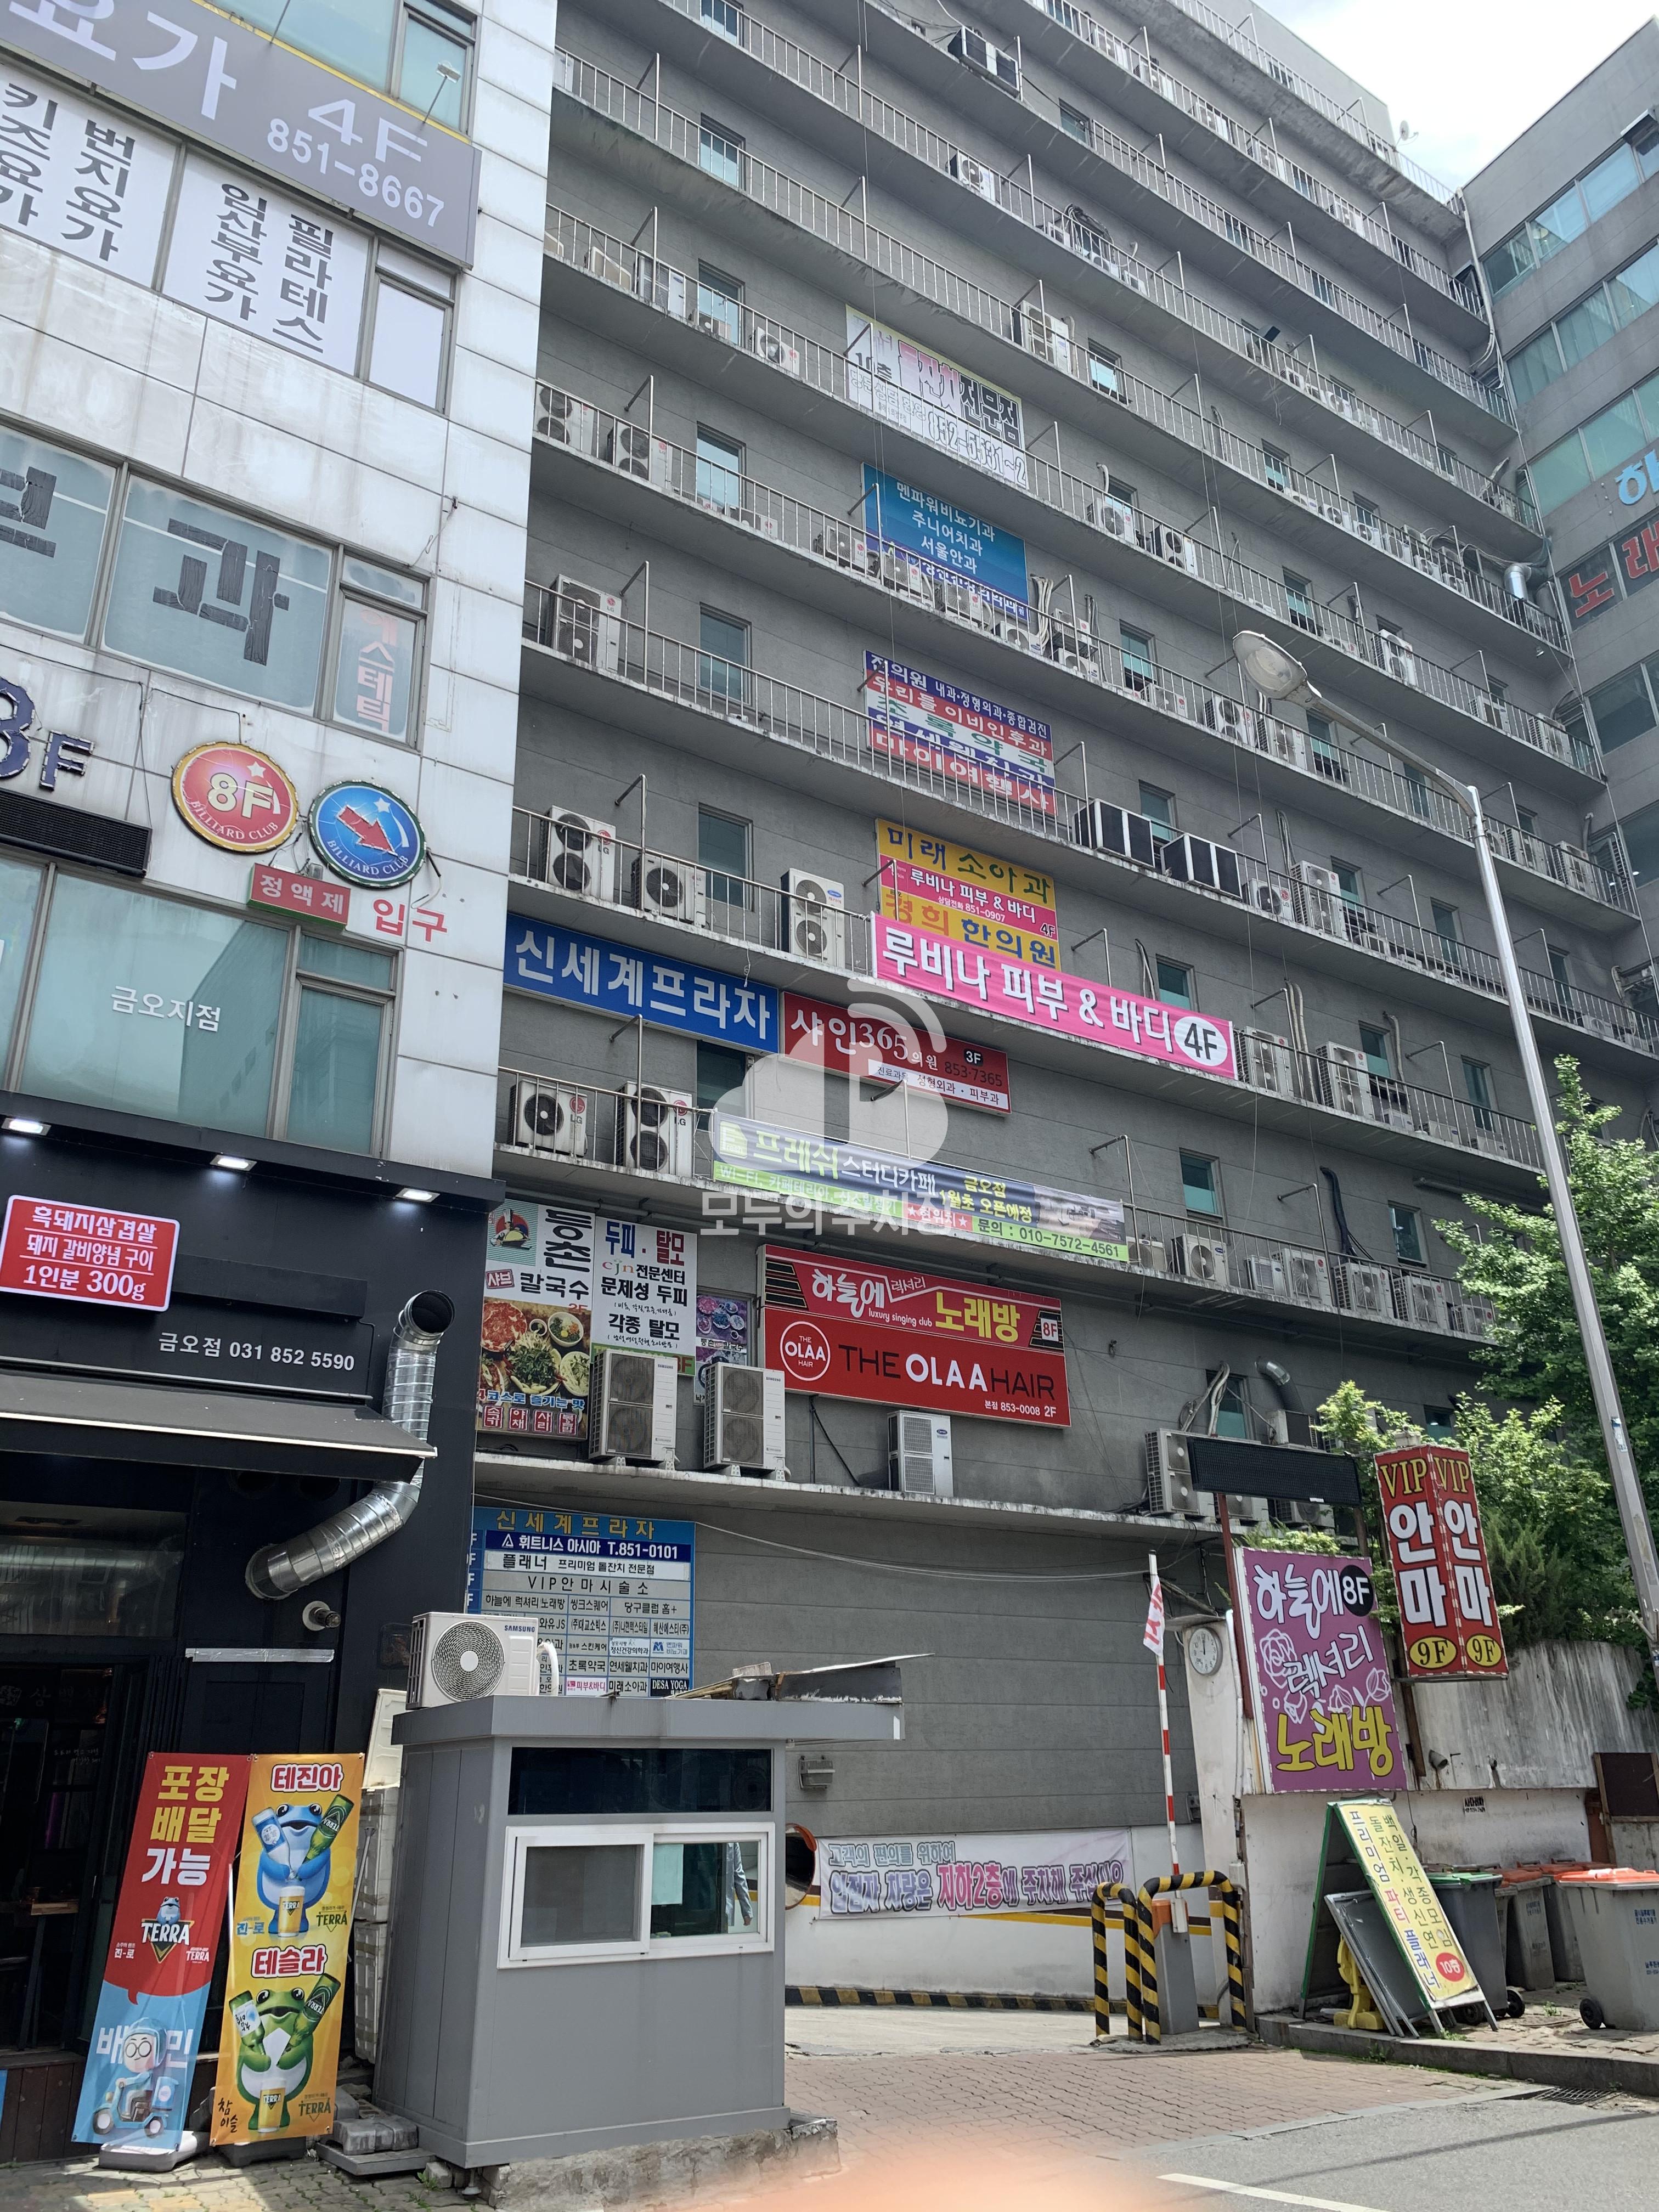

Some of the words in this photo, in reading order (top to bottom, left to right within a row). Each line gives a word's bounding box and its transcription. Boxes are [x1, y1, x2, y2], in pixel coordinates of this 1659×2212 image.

[307, 98, 428, 163] 4F
[267, 118, 445, 228] 851-8667
[204, 183, 268, 321] 임산부요가
[272, 214, 334, 354] 필라테스
[960, 373, 1021, 449] 전문점
[896, 481, 996, 543] 멘파워비뇨기과
[911, 509, 983, 557] 주니어치과
[921, 535, 978, 575] 서울안과
[876, 732, 1049, 810] 마이여행사
[207, 772, 274, 819] 8F
[191, 800, 245, 840] BILLIARD
[248, 821, 279, 840] CLUB
[327, 839, 380, 876] BILLIARD
[382, 855, 409, 875] CLUB
[259, 873, 345, 915] 정액제
[910, 868, 956, 898] 루비나
[960, 884, 989, 906] 피부
[992, 896, 1005, 912] &
[1007, 899, 1036, 924] 바디
[937, 895, 964, 911] 상담전화
[964, 902, 1006, 923] 851-0907
[373, 898, 448, 943] 입구
[1040, 923, 1056, 937] 4F
[515, 930, 770, 1041] 신세계프라자
[882, 927, 991, 1001] 루비나
[1001, 963, 1069, 1021] 피부
[1079, 989, 1104, 1028] &
[1109, 996, 1173, 1053] 바디
[1183, 1022, 1217, 1060] 4F
[110, 985, 221, 1033] 금오지점
[966, 1050, 981, 1064] 3F
[917, 1074, 956, 1094] 성형외과
[969, 1087, 1000, 1105] 피부과
[753, 1130, 839, 1180] 프레쉬
[840, 1155, 936, 1197] 스터디카페
[964, 1175, 1007, 1199] 금오점
[32, 1206, 157, 1243] 흑돼지삼겹살
[939, 1189, 975, 1212] 1월초
[979, 1197, 1032, 1224] 오픈예정
[27, 1233, 58, 1257] 돼지
[62, 1238, 121, 1266] 갈비양념
[124, 1251, 154, 1272] 구이
[543, 1209, 592, 1273] 등촌
[605, 1221, 636, 1258] 두피
[656, 1229, 685, 1266] 탈모
[977, 1218, 1003, 1237] 문의
[1019, 1227, 1120, 1257] 010-7572-4561
[24, 1264, 80, 1291] 1인분
[86, 1269, 145, 1301] 300g
[520, 1272, 589, 1300] 칼국수
[601, 1276, 649, 1301] 문제성
[657, 1285, 687, 1307] 두피
[636, 1264, 685, 1285] 전문센터
[811, 1268, 885, 1318] 하늘에
[890, 1276, 926, 1294] 럭셔리
[934, 1291, 1021, 1343] 노래방
[1042, 1318, 1059, 1340] 8F
[868, 1307, 890, 1323] luxury
[891, 1312, 917, 1328] singing
[918, 1316, 933, 1328] club
[608, 1313, 641, 1334] 각종
[649, 1319, 680, 1340] 탈모
[799, 1335, 812, 1344] THE
[159, 1331, 222, 1358] 금오점
[229, 1342, 262, 1361] 031
[270, 1346, 304, 1366] 852
[311, 1351, 355, 1372] 5590
[785, 1340, 826, 1362] OLAA
[798, 1360, 814, 1368] HAIR
[838, 1344, 901, 1379] THE
[991, 1367, 1056, 1401] HAIR
[512, 1409, 526, 1429] 야채
[530, 1394, 568, 1409] 즐기는
[572, 1399, 585, 1410] 맛
[984, 1400, 998, 1411] 본점
[1000, 1401, 1041, 1417] 853-0008
[1043, 1405, 1057, 1418] 2F
[538, 1412, 550, 1431] 사리
[1380, 1457, 1427, 1498] VIP
[1433, 1456, 1470, 1494] VIP
[496, 1510, 654, 1540] 신세계프라자
[503, 1554, 547, 1570] 플래너
[558, 1559, 595, 1572] 프리미엄
[599, 1561, 625, 1573] 돌잔치
[628, 1564, 654, 1575] 전문점
[519, 1534, 564, 1551] 휘트니스
[567, 1538, 601, 1555] 아시아
[607, 1541, 678, 1560] T.851-0101
[1389, 1500, 1448, 1628] 안마
[1443, 1499, 1494, 1627] 안마
[486, 1594, 511, 1607] 하늘에
[515, 1596, 539, 1609] 럭셔리
[541, 1598, 565, 1611] 노래방
[624, 1601, 659, 1615] 당구클럽
[1253, 1563, 1344, 1640] 하늘에
[1342, 1576, 1372, 1606] 8F
[581, 1643, 607, 1651] 스킨케어
[610, 1646, 648, 1655] 정신건강의학과
[1419, 1639, 1449, 1666] 9F
[1471, 1637, 1497, 1663] 9F
[568, 1659, 606, 1673] 초록약국
[651, 1662, 689, 1674] 마이여행사
[576, 1680, 606, 1691] 피부&바디
[608, 1680, 647, 1692] 미래소아과
[652, 1679, 669, 1690] DESA
[670, 1679, 688, 1691] YOGA
[1276, 1705, 1394, 1777] 노래방
[157, 1765, 230, 1803] 포장
[273, 1764, 344, 1791] 테진아
[150, 1807, 222, 1844] 배달
[1381, 1814, 1408, 1852] 백일
[829, 1842, 870, 1867] 고객의
[873, 1841, 913, 1866] 편의를
[917, 1840, 956, 1864] 위하여
[1369, 1816, 1404, 1875] 돌잔치
[140, 1847, 212, 1886] 가능
[830, 1870, 881, 1914] 입점자
[884, 1869, 934, 1912] 차량은
[936, 1860, 1019, 1910] 지하2층에
[1021, 1864, 1068, 1906] 주차해
[1348, 1810, 1391, 1883] 프리미엄
[1384, 1888, 1410, 1924] 파티
[1404, 1929, 1442, 1989] 플래너
[141, 1922, 190, 1945] TERRA
[315, 1911, 348, 1927] TERRA
[185, 1950, 210, 1962] TERRA
[254, 1948, 325, 1975] 테슬라
[1439, 1960, 1462, 1974] 10층
[263, 2093, 282, 2104] TERRA
[298, 2101, 331, 2117] TERRA
